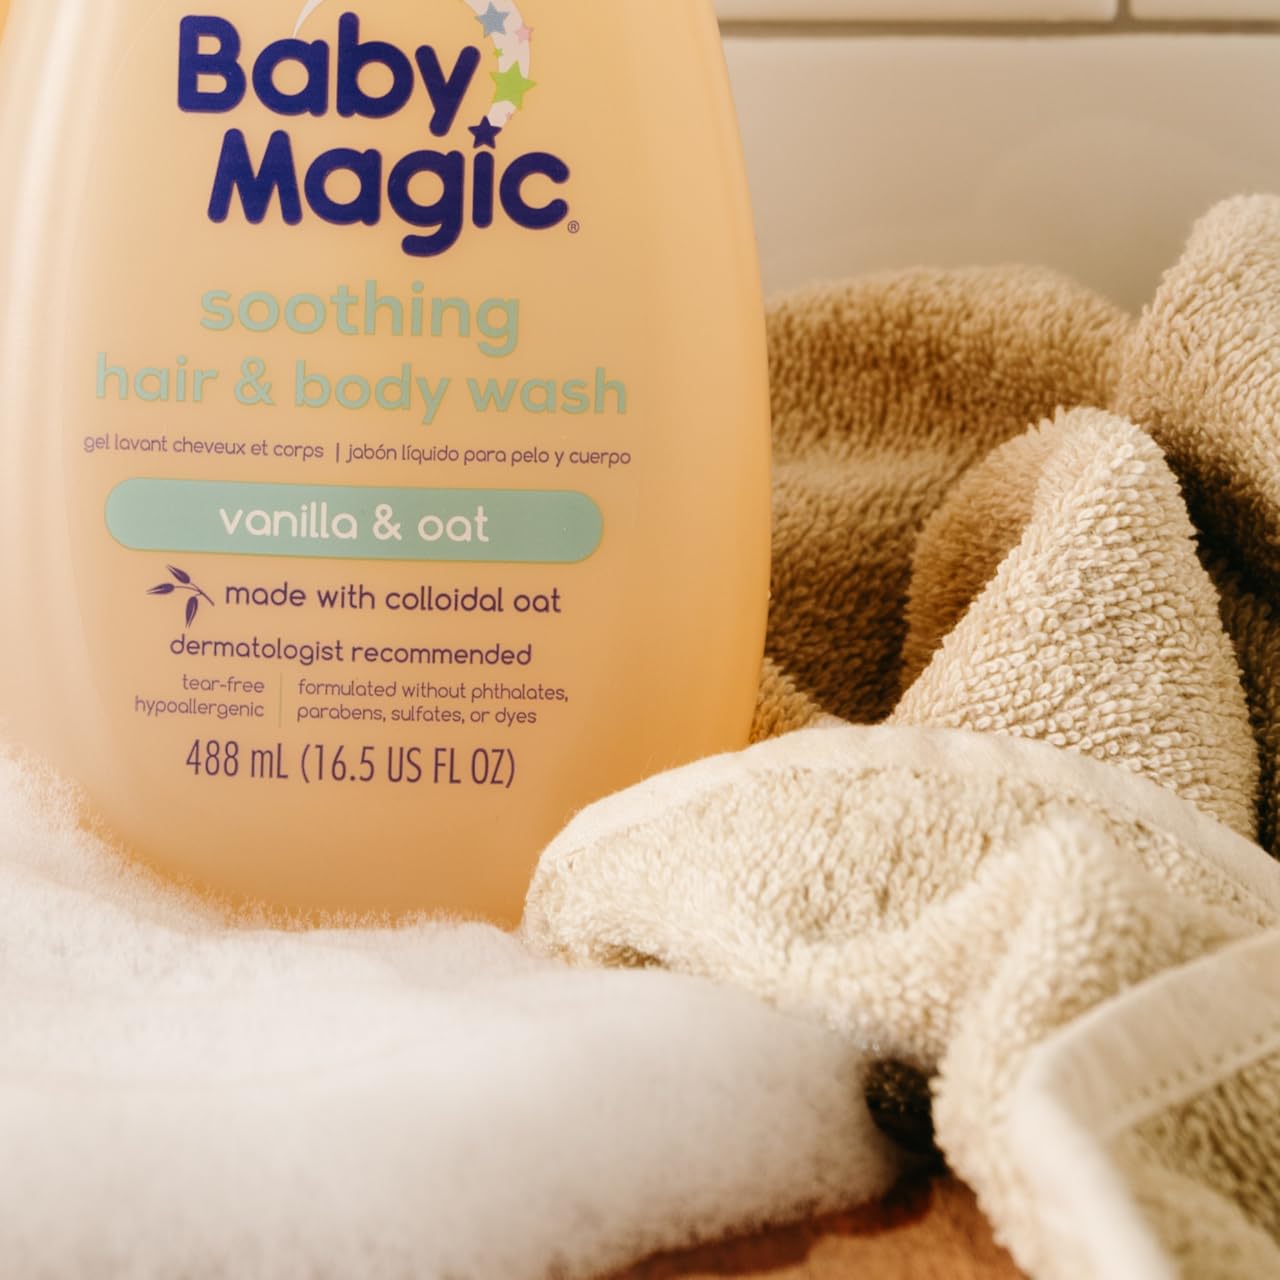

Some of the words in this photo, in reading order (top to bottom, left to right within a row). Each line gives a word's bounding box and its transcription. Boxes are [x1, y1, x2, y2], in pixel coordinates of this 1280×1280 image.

[177, 12, 480, 137] Baby
[200, 280, 519, 357] soothing
[96, 352, 218, 403] hair
[234, 356, 277, 406] &
[294, 360, 450, 425] body
[466, 367, 628, 415] wash
[83, 433, 110, 453] gel
[114, 433, 168, 453] lavant
[173, 437, 246, 455] cheveux
[250, 440, 268, 456] et
[273, 441, 324, 462] corps
[346, 443, 397, 464] jabón
[401, 444, 459, 464] líquido
[464, 448, 506, 466] para
[510, 446, 550, 466] pelo
[554, 450, 564, 467] y
[569, 448, 631, 468] cuerpo
[219, 502, 358, 540] vanilla
[373, 504, 402, 541] &
[418, 506, 489, 543] oat
[225, 581, 306, 608] made
[317, 584, 375, 610] with
[385, 585, 503, 613] colloidal
[513, 588, 562, 614] oat
[169, 634, 344, 666] dermatologist
[351, 642, 532, 666] recommended
[182, 674, 265, 694] tear-free
[298, 679, 397, 698] formulated
[401, 681, 466, 699] without
[471, 682, 569, 704] phthalates,
[135, 696, 265, 720] hypoallergenic
[297, 703, 387, 723] parabens,
[391, 705, 465, 725] sulfates,
[470, 708, 490, 723] or
[495, 707, 537, 728] dyes
[186, 739, 240, 777] 488
[250, 743, 288, 779] mL
[300, 743, 375, 784] (16.5
[387, 746, 422, 783] US
[434, 748, 461, 784] FL
[471, 748, 516, 788] OZ)
